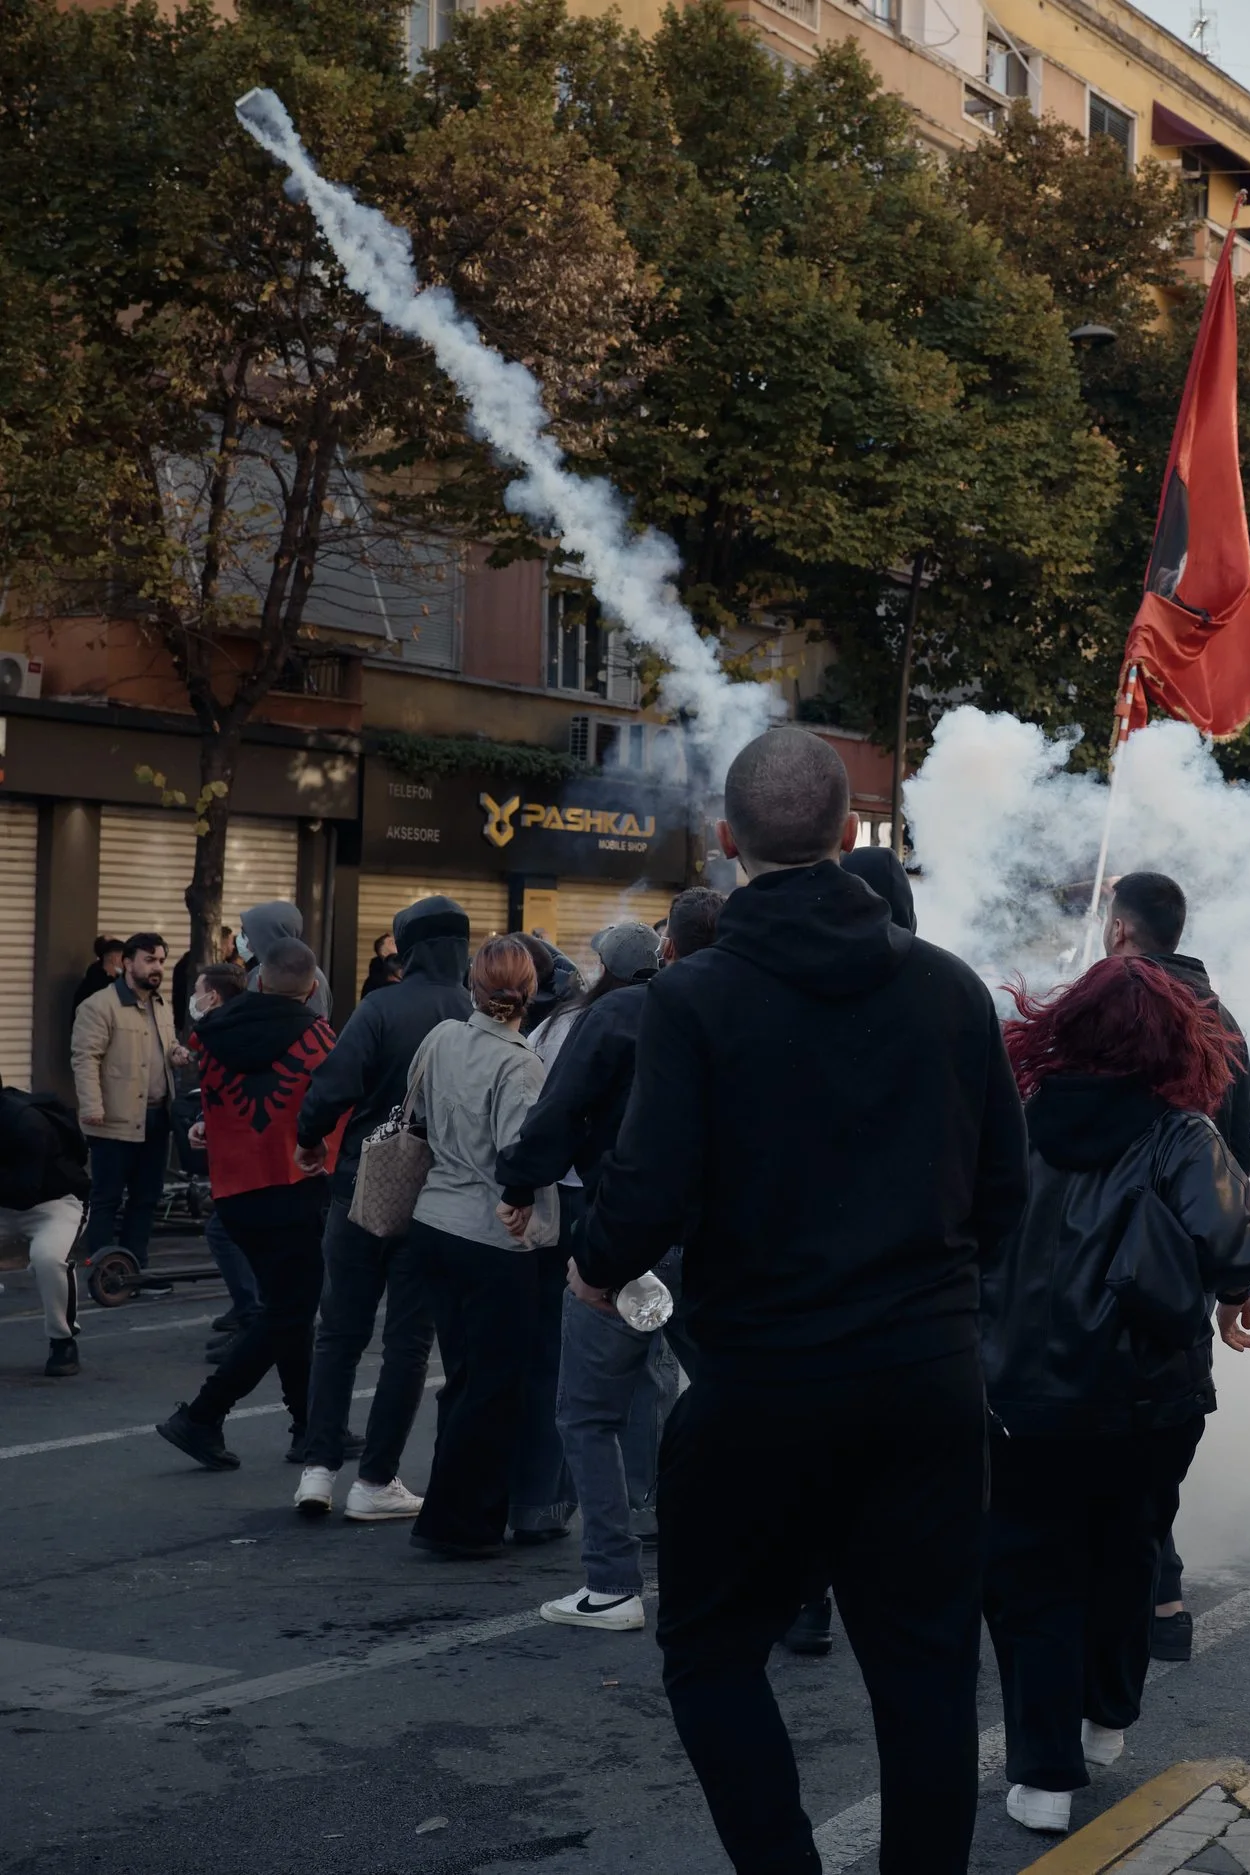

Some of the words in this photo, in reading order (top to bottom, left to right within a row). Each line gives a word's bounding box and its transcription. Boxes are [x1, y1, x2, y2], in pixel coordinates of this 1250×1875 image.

[388, 783, 432, 799] TELEFON
[521, 803, 655, 837] PASHKAJ
[386, 825, 440, 842] AKSESORE
[598, 839, 626, 851] MOBILE
[627, 841, 648, 853] SHOP
